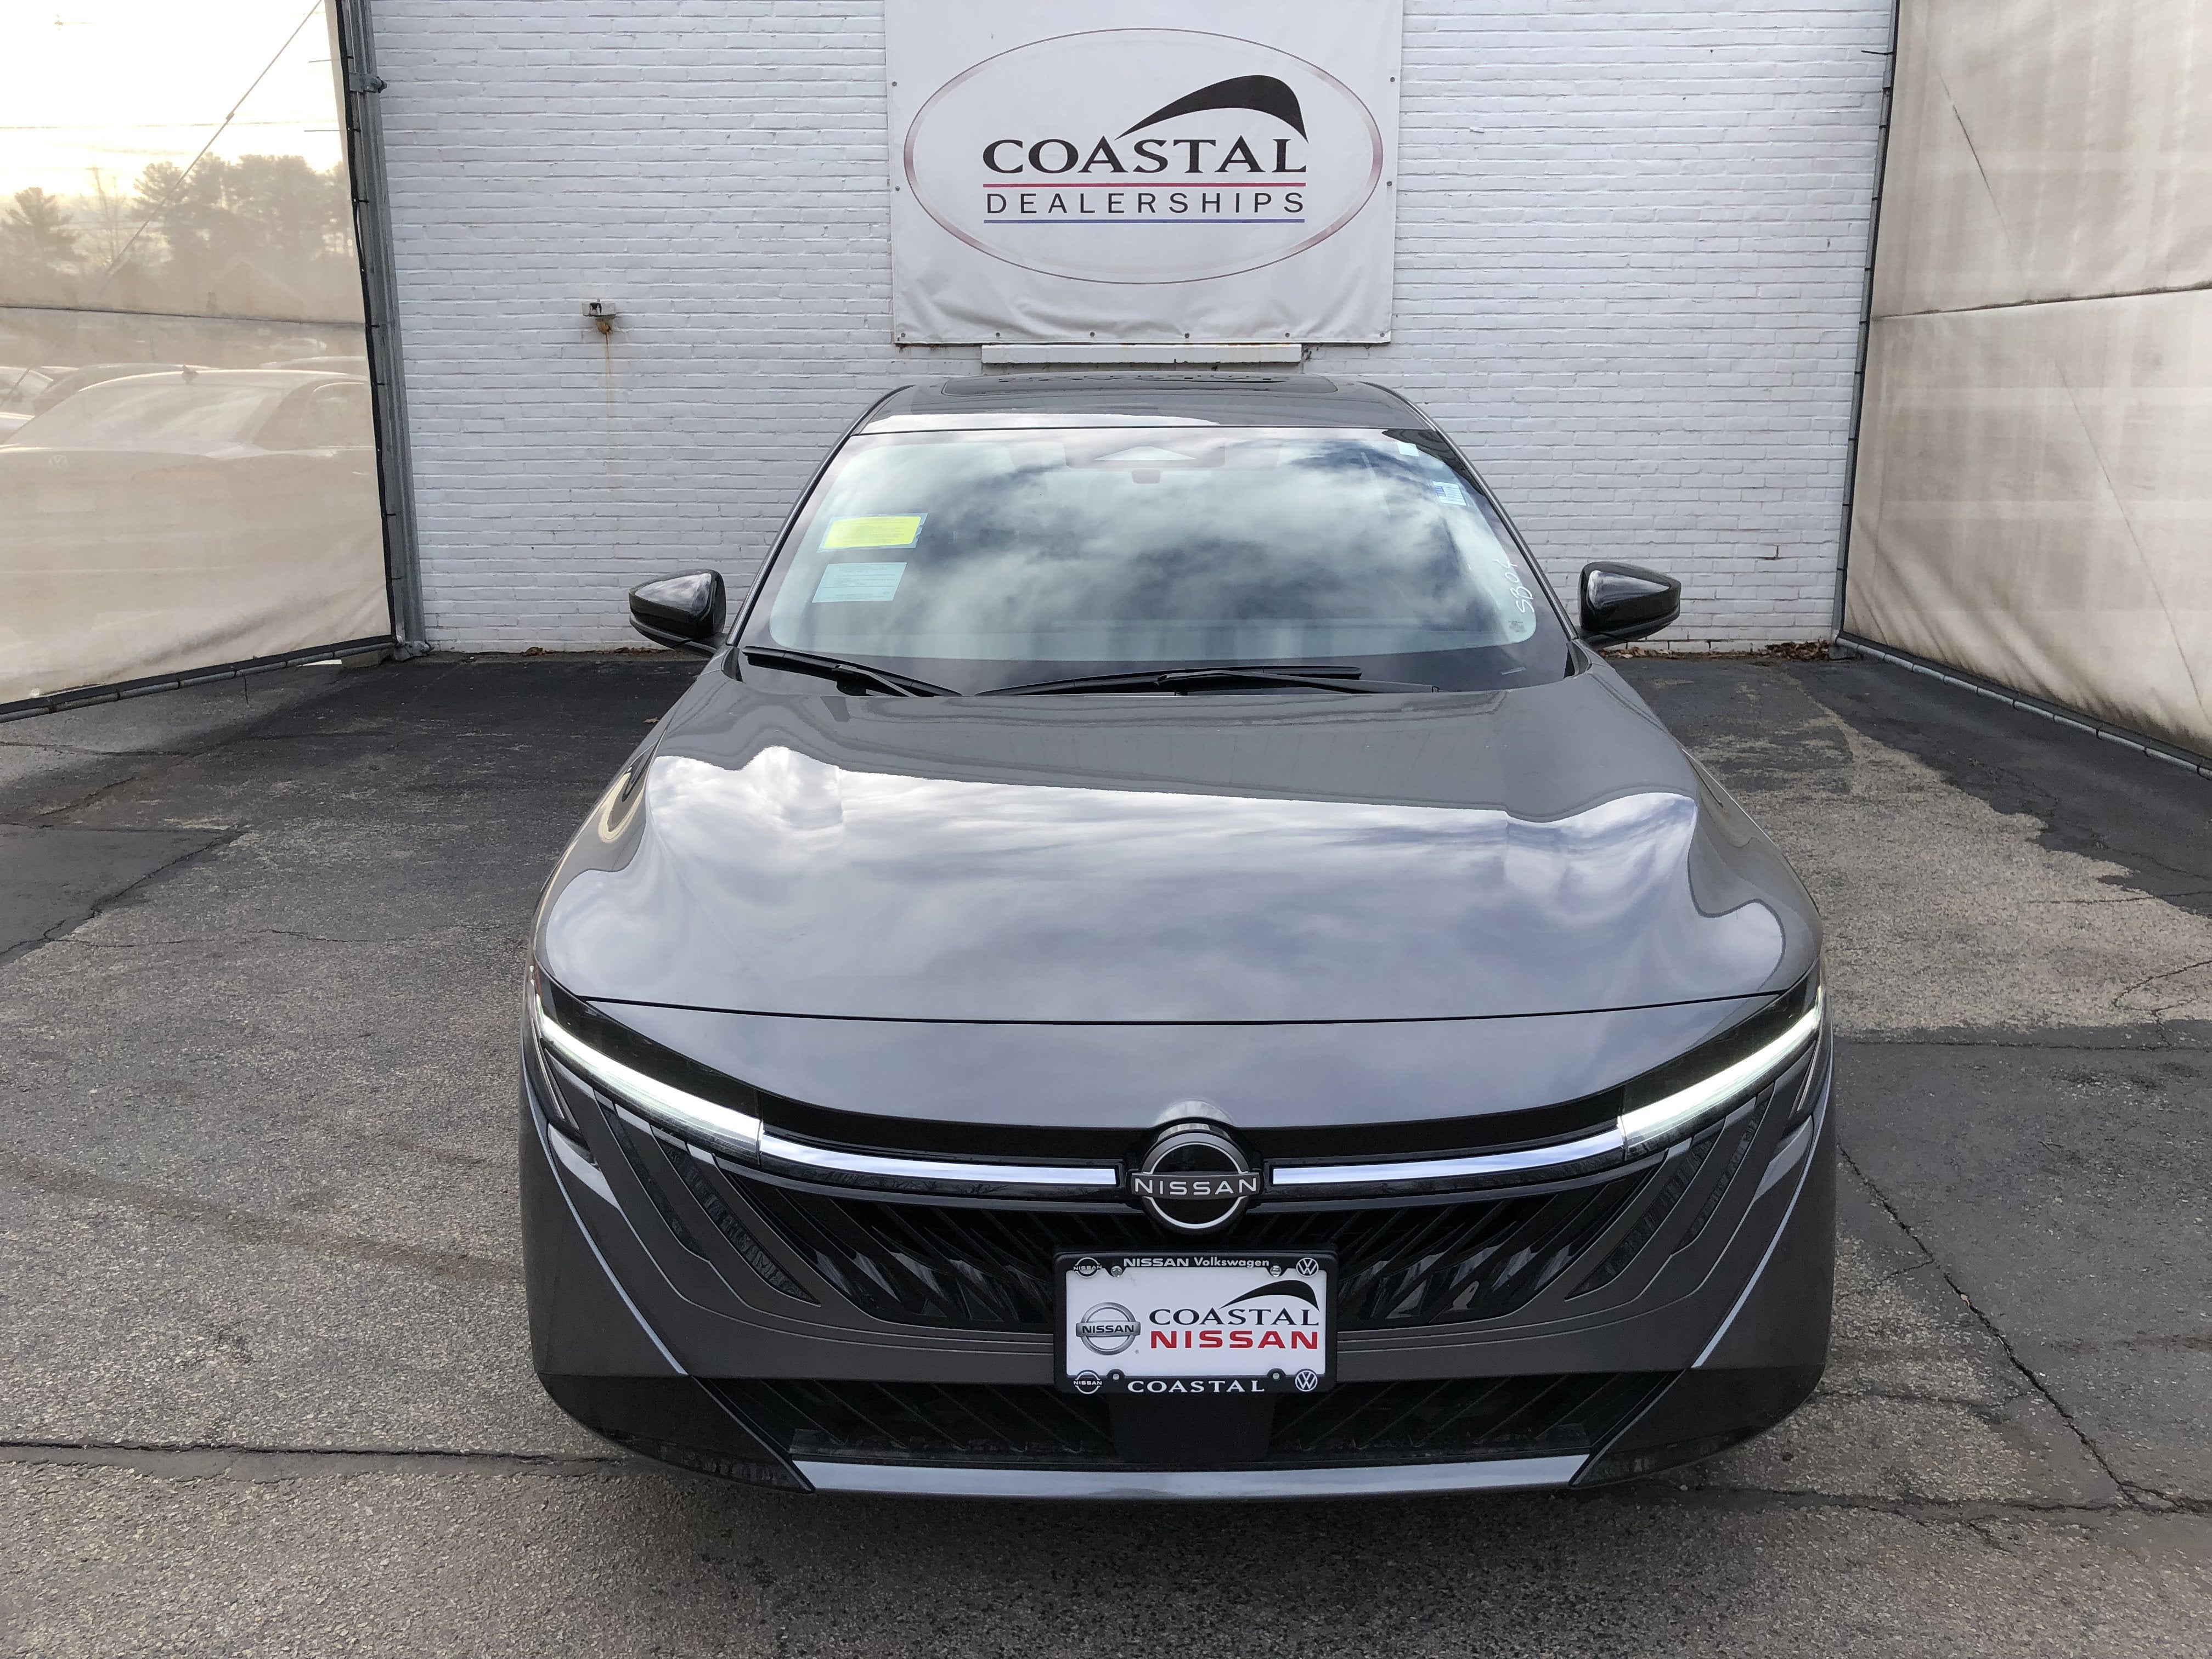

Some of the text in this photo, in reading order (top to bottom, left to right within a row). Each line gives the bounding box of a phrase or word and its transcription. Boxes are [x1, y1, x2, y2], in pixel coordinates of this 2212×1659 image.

[983, 136, 1307, 174] COASTAL
[987, 192, 1304, 214] DEALERSHIPS
[1135, 1177, 1256, 1195] NISSAN
[1123, 1256, 1269, 1268] NISSAN Volkswagen
[1149, 1307, 1319, 1326] COASTAL
[1082, 1324, 1135, 1334] NISSAN
[1150, 1330, 1318, 1350] NISSAN
[1127, 1379, 1265, 1393] COASTAL
